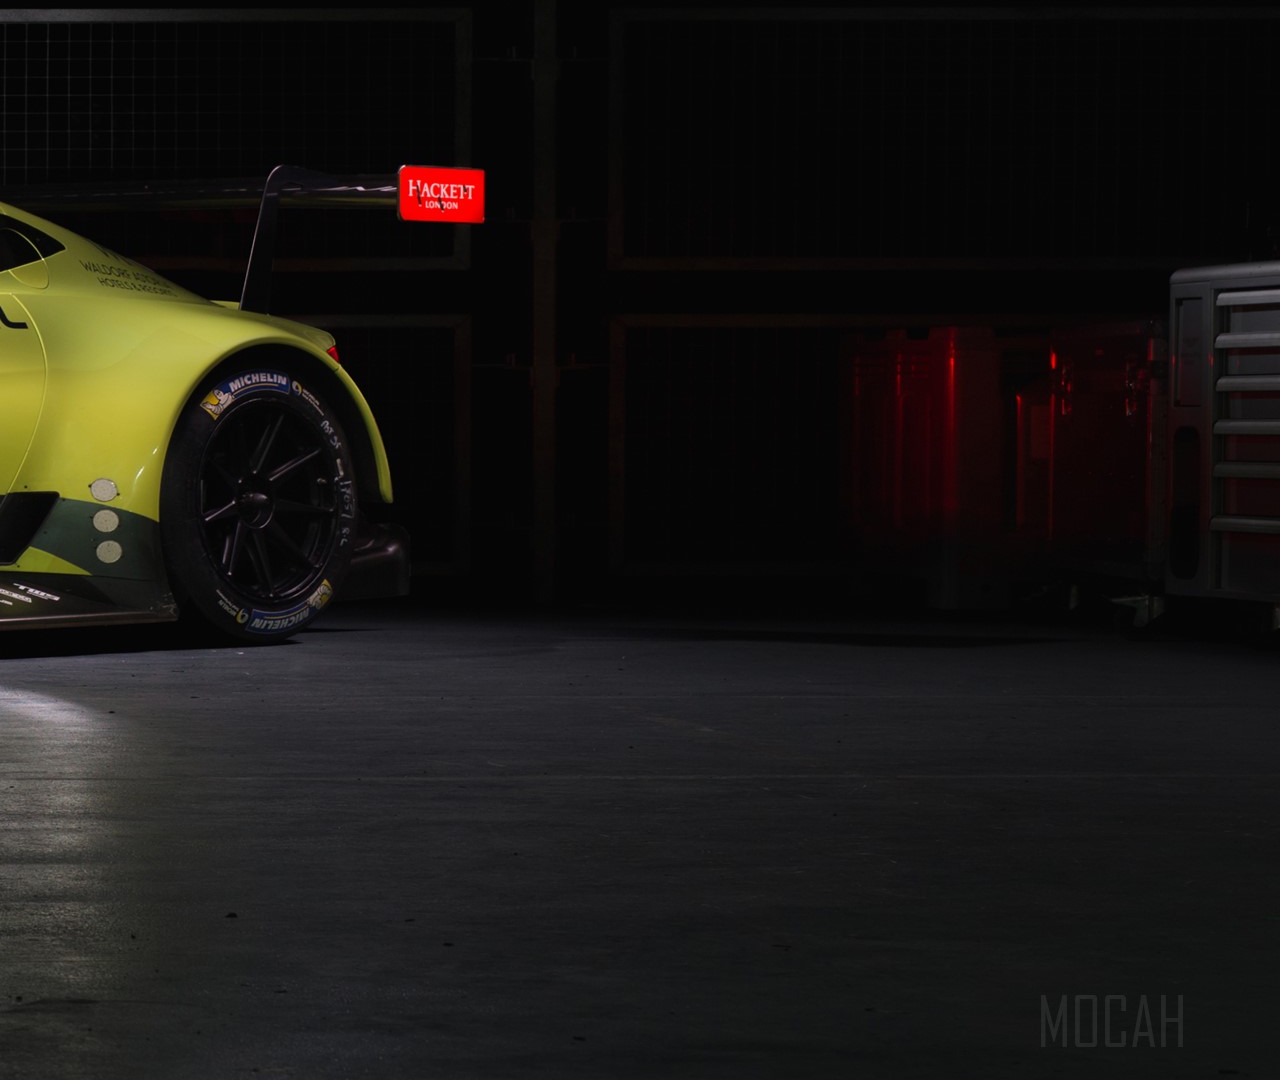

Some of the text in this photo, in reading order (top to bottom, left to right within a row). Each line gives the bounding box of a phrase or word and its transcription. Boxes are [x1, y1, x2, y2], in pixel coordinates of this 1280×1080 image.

[408, 179, 475, 200] HACKETT
[228, 372, 288, 393] MICHELIN
[250, 607, 311, 630] MICHELIN
